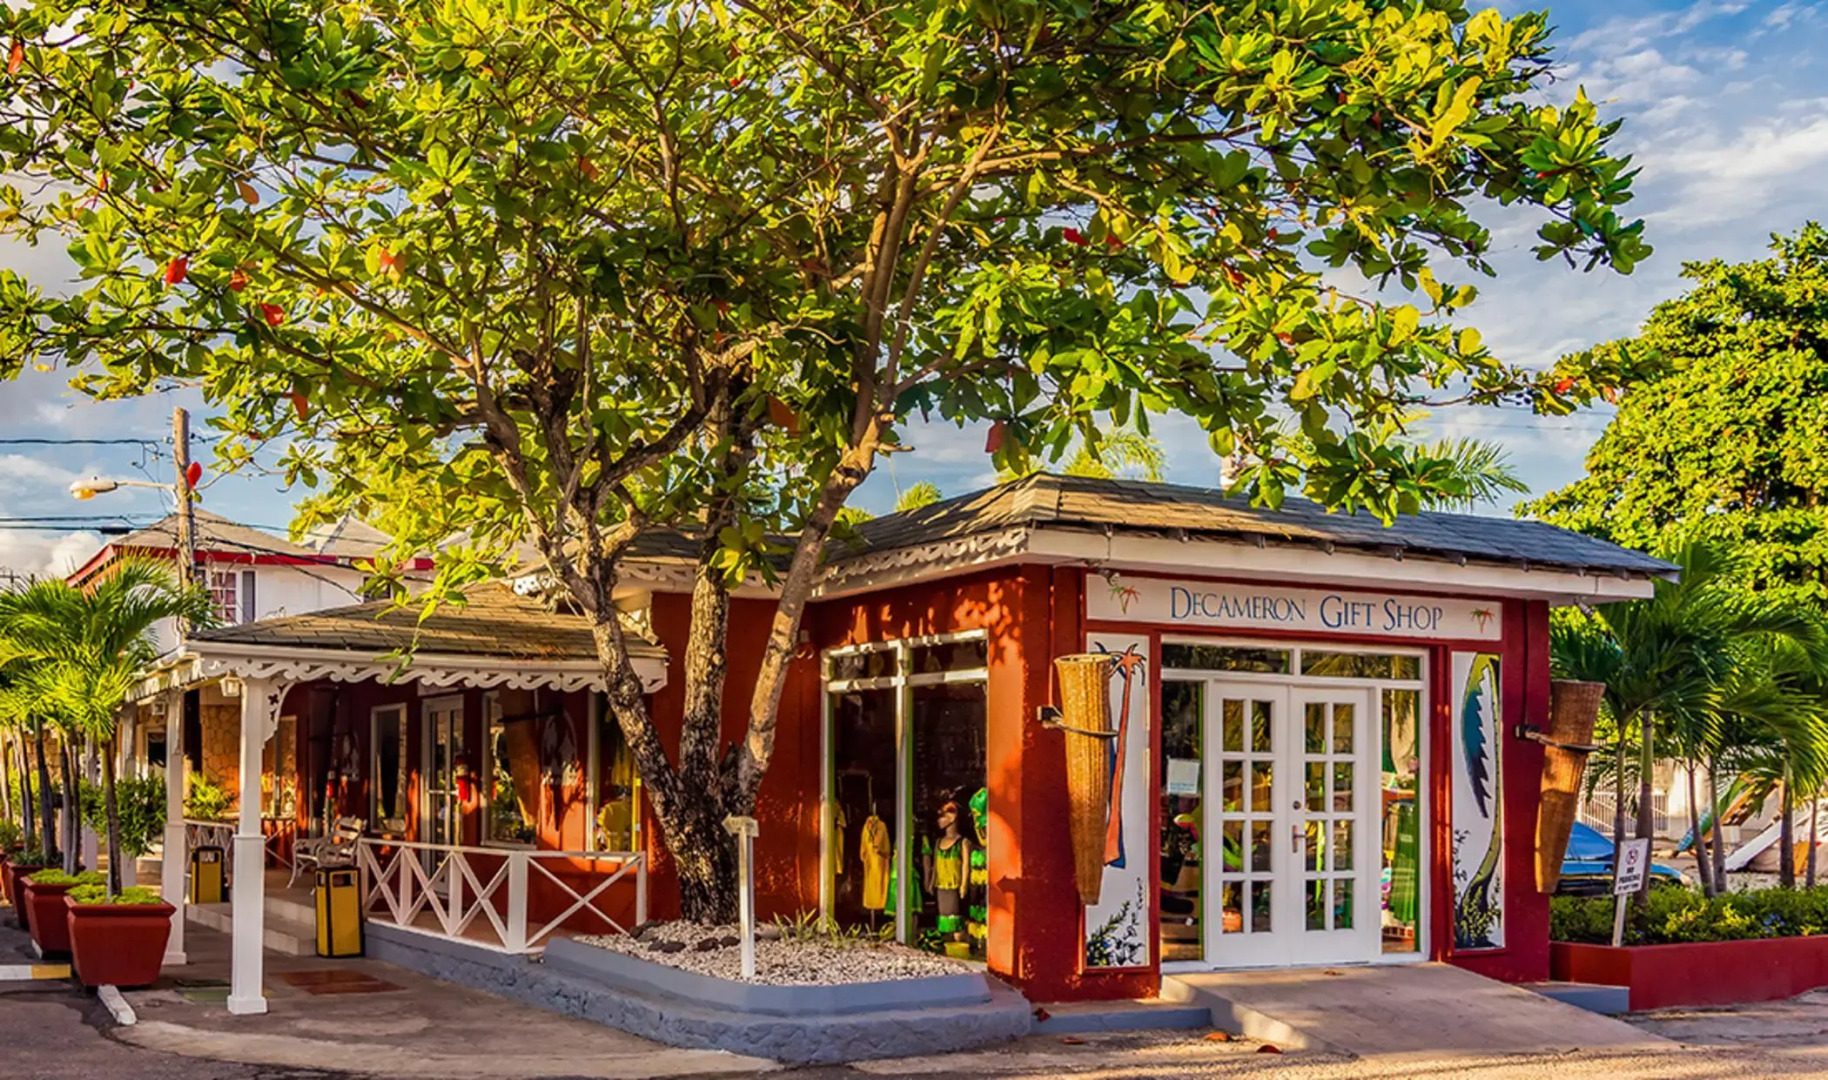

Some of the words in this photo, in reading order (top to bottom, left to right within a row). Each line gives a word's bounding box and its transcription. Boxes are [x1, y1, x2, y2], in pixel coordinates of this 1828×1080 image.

[1171, 587, 1306, 621] DECAMERON
[1319, 595, 1377, 629] GIFT
[1382, 598, 1443, 631] SHOP
